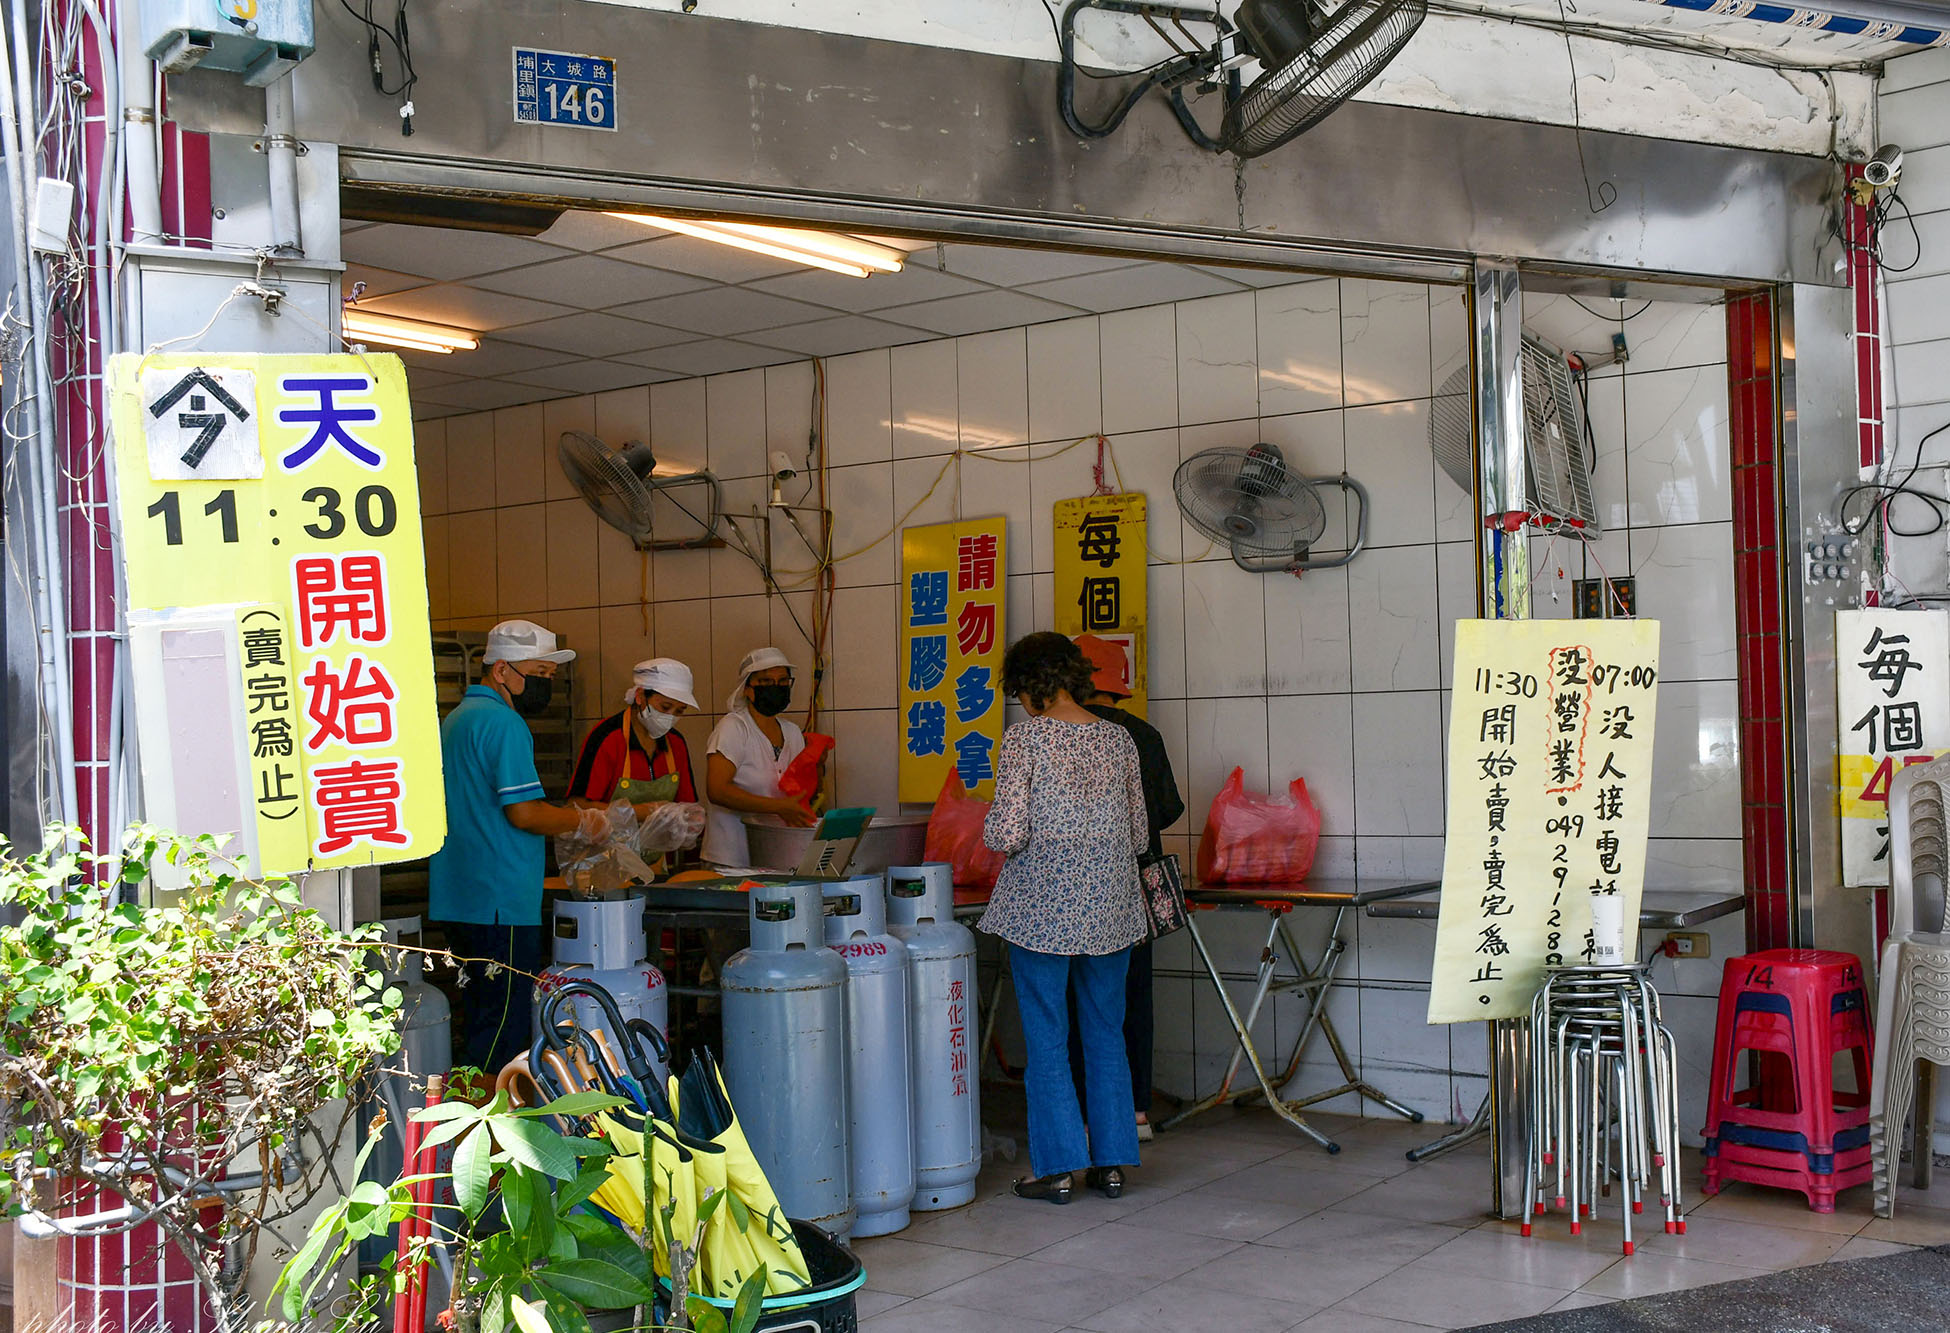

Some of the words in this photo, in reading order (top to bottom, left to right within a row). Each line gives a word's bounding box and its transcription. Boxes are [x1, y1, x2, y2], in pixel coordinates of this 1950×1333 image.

[541, 59, 607, 80] 大城路
[544, 83, 605, 124] 146
[149, 366, 382, 470] 今天
[147, 484, 398, 546] 11:30
[1077, 512, 1121, 633] 每個
[295, 555, 407, 854] 開始賣
[906, 570, 949, 758] 塑膠袋
[953, 533, 998, 791] 請勿多拿
[1475, 667, 1538, 698] 11:30
[1851, 626, 1924, 756] 每個
[828, 942, 888, 959] 2989
[1744, 964, 1775, 990] 14
[946, 980, 968, 1097] 液化石油氣
